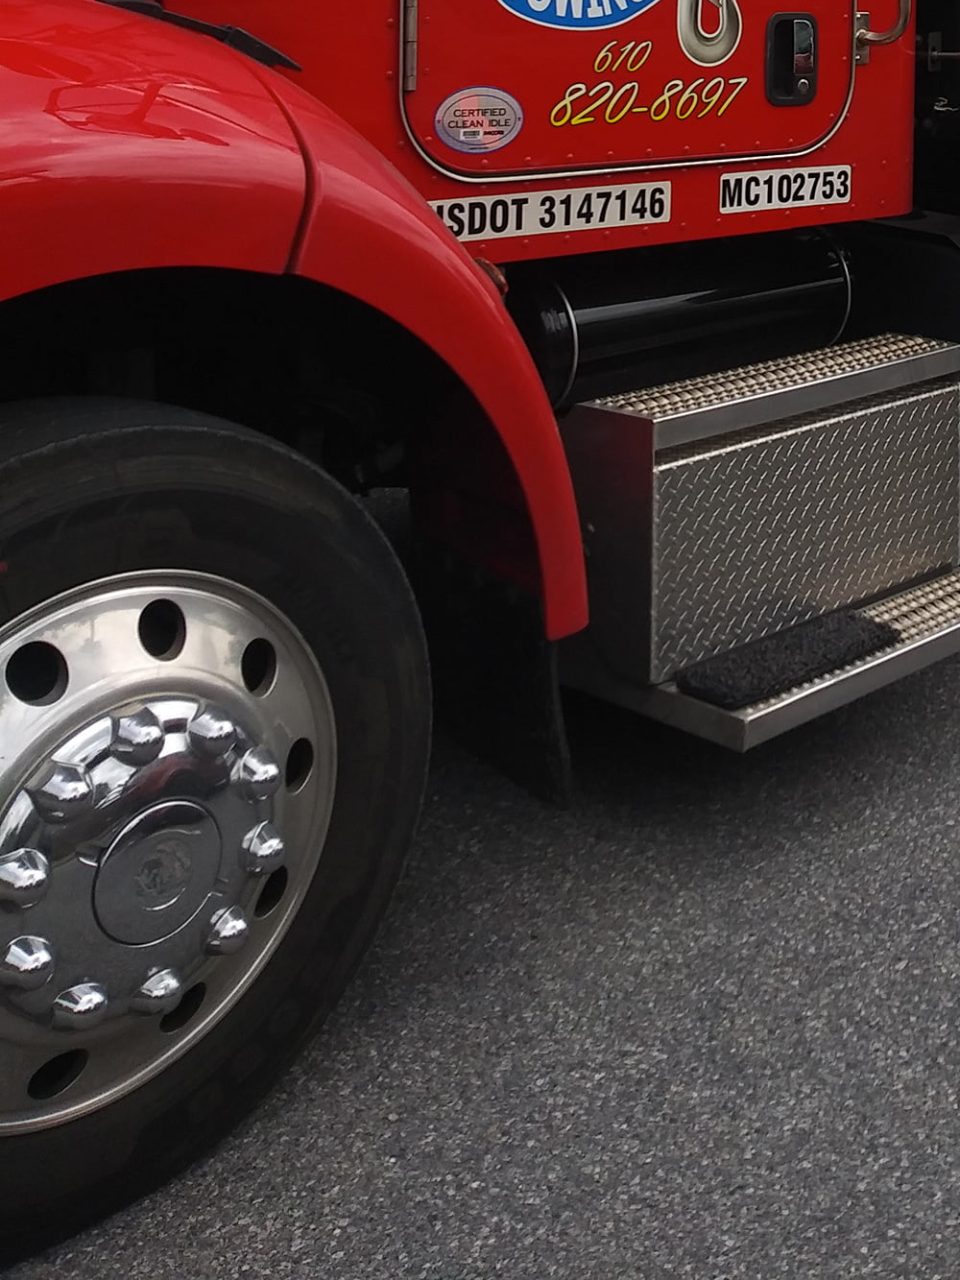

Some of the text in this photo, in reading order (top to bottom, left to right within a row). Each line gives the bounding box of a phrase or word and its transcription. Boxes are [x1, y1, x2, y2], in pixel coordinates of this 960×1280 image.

[594, 40, 652, 72] 610
[453, 108, 507, 118] CERTIFIED
[550, 77, 748, 126] 820-8697
[448, 118, 511, 129] CLEAN IDLE
[721, 170, 849, 208] MC102753
[436, 186, 665, 237] SDOT 3147146
